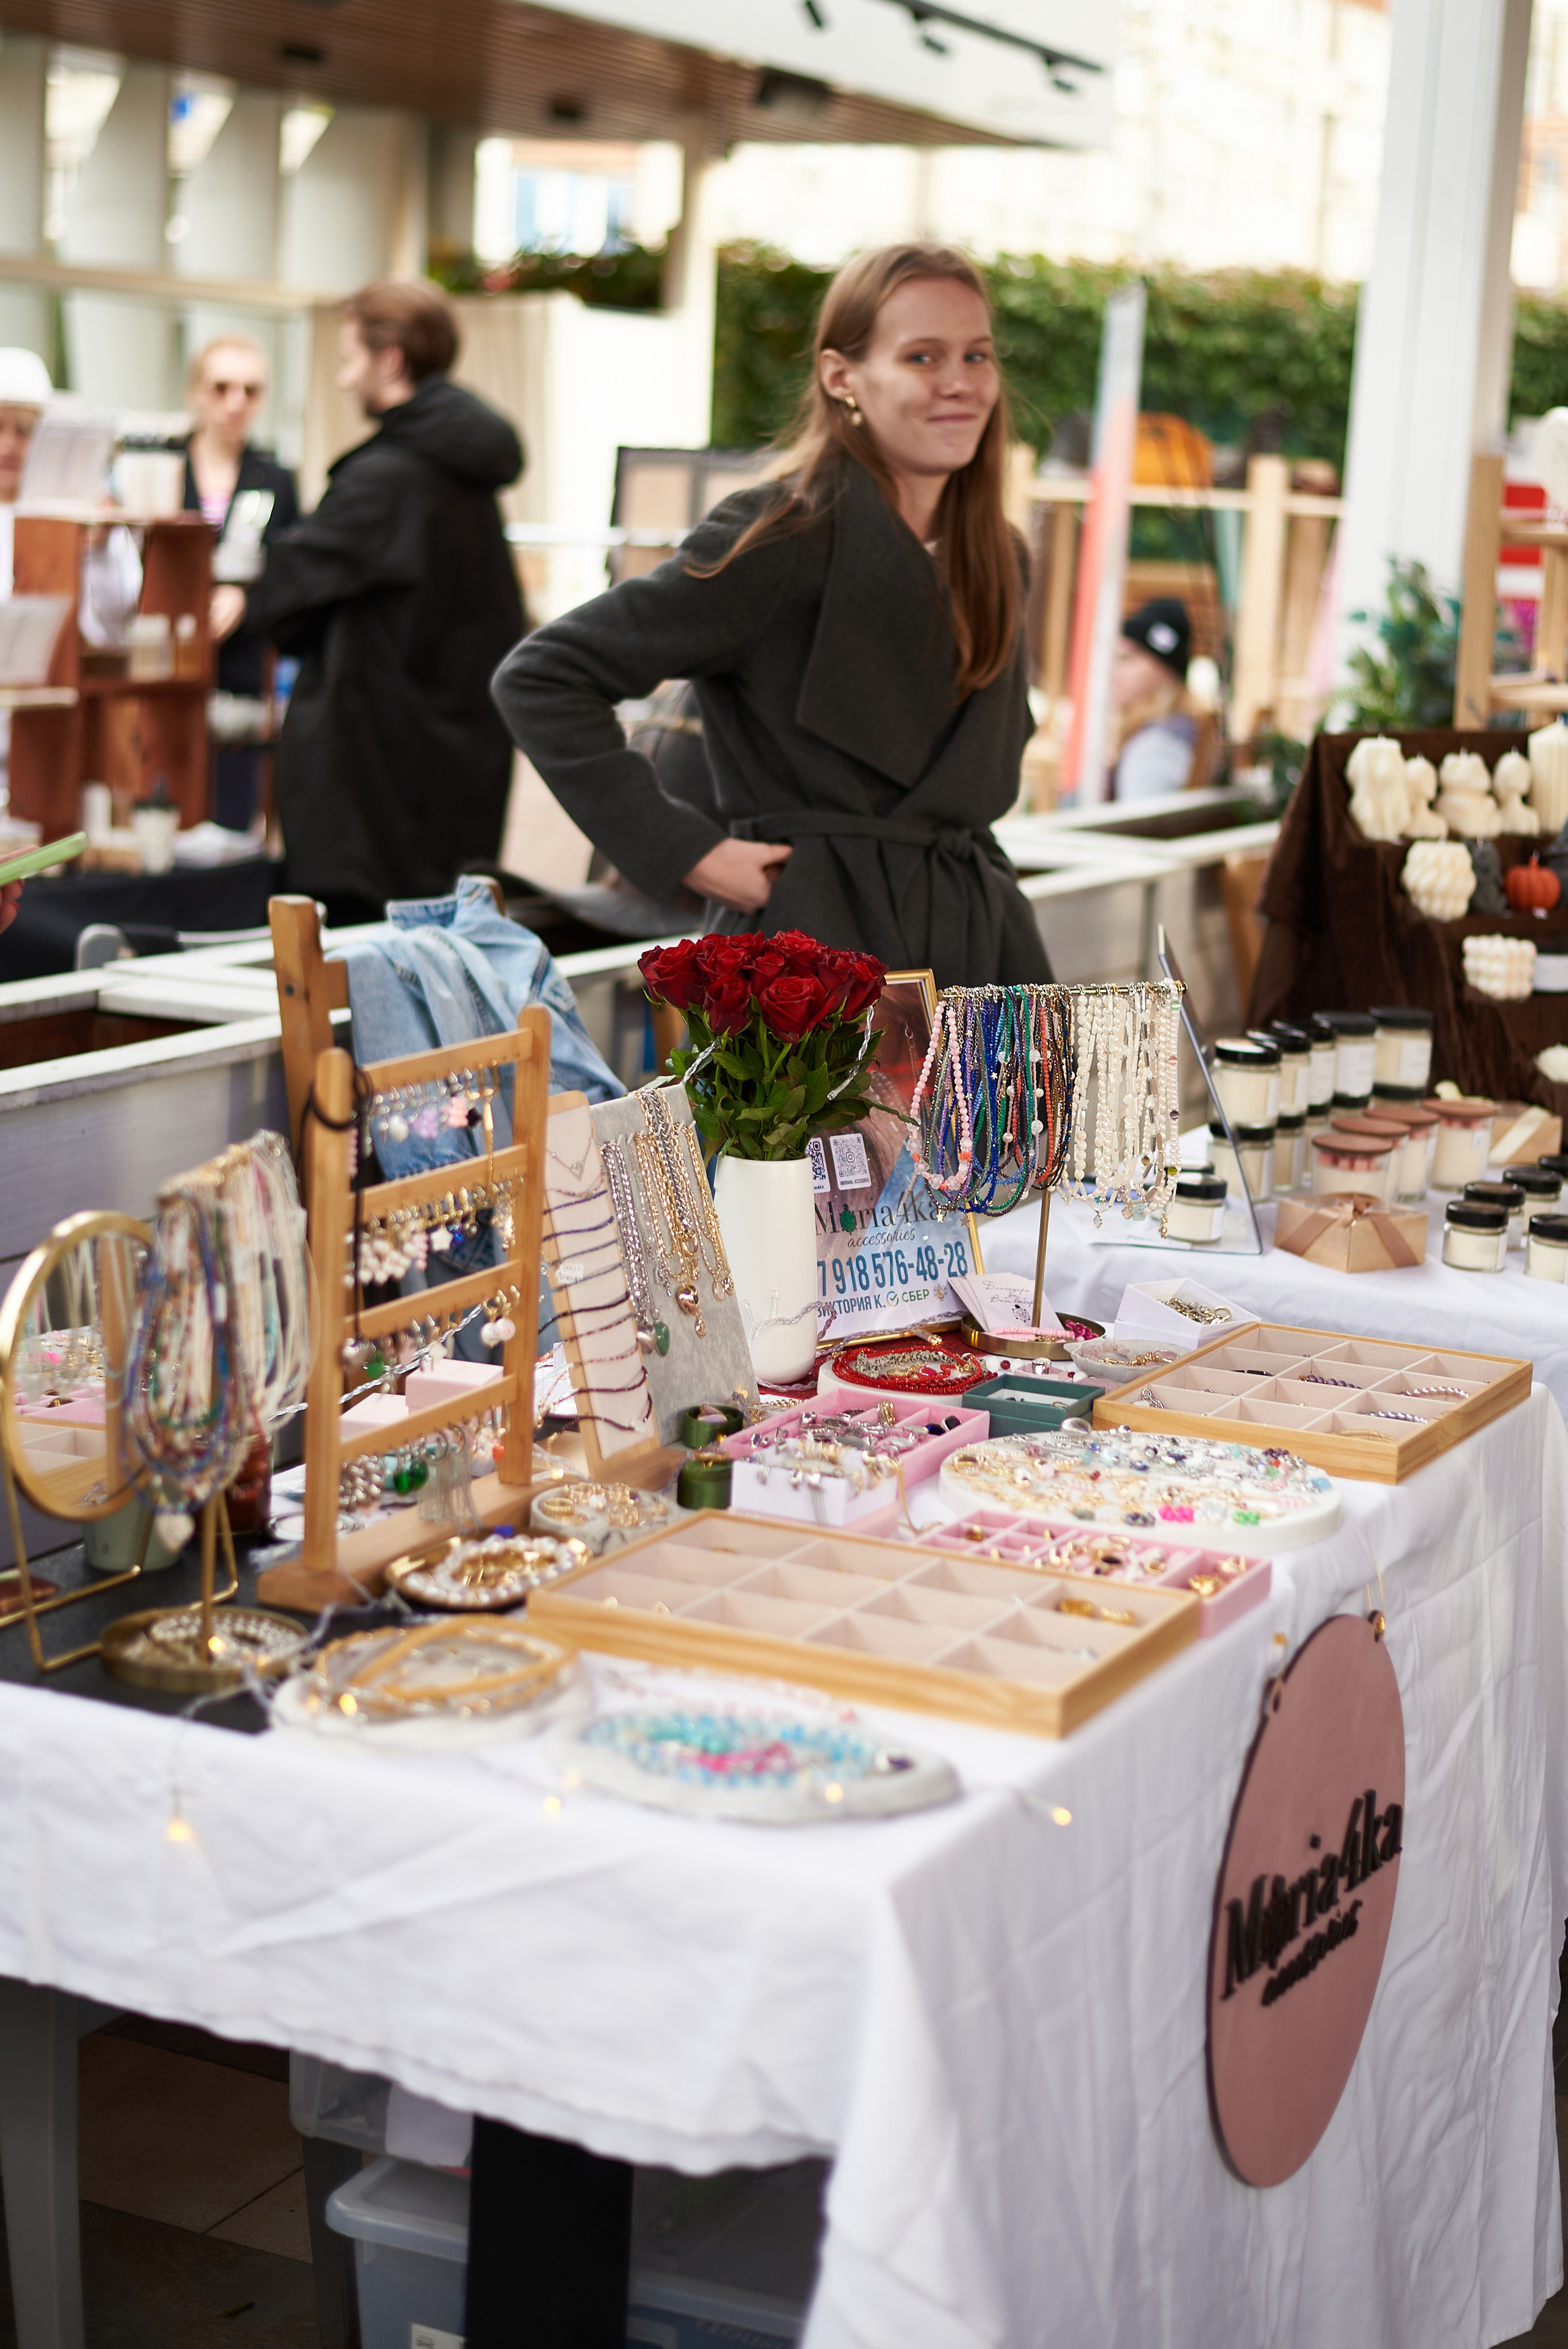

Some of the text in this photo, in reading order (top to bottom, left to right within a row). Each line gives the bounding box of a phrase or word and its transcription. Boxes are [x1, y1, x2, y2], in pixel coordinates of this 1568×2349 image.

[848, 1228, 916, 1248] accessories
[832, 1254, 870, 1294] 918
[872, 1241, 968, 1289] 576-48-28
[902, 1289, 930, 1303] СБЕР
